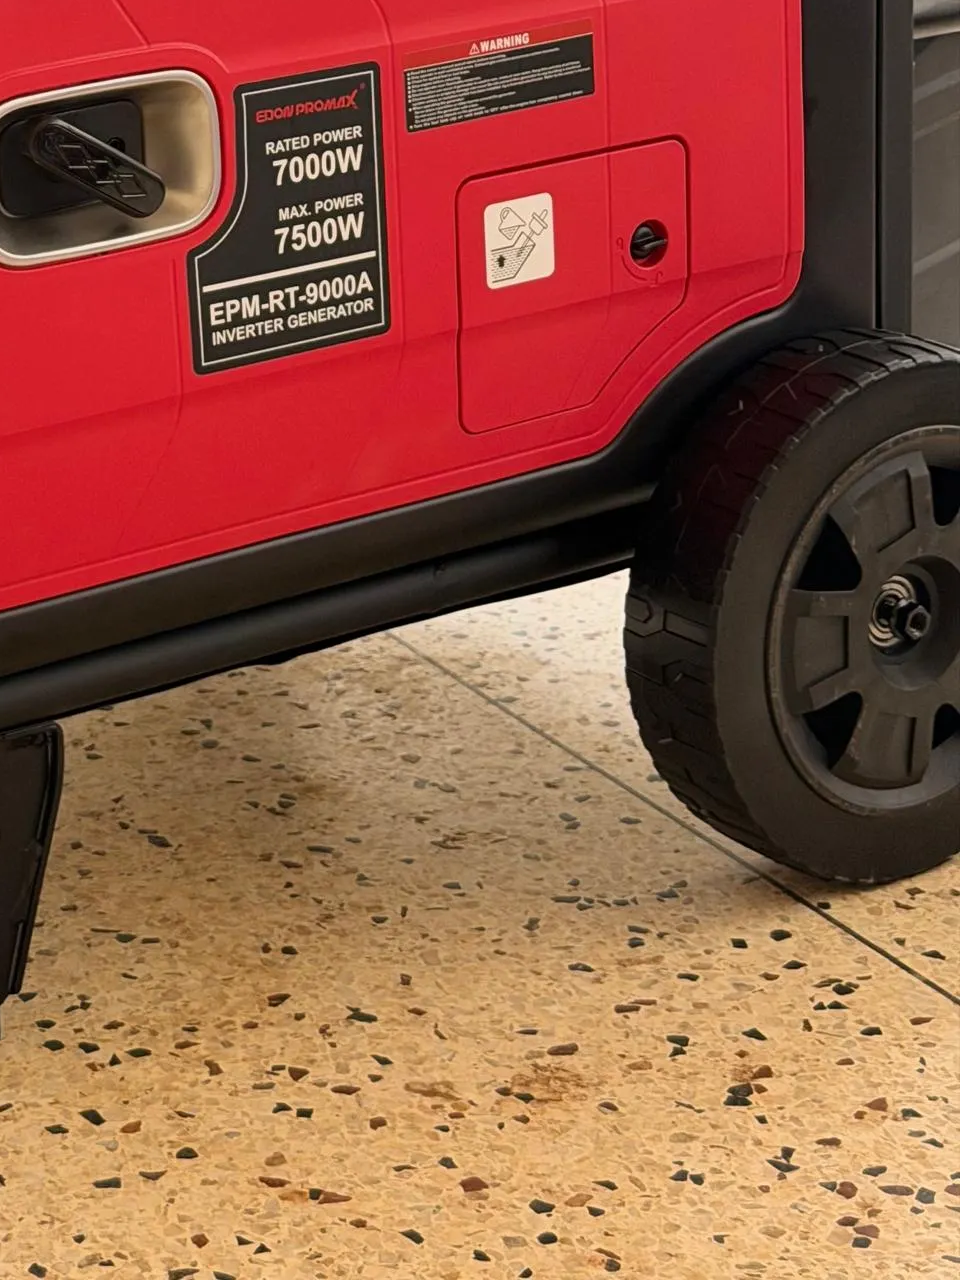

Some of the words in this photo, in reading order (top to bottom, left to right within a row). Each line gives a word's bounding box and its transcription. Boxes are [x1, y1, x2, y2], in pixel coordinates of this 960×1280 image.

[480, 33, 530, 53] WARNING
[255, 104, 295, 124] EDON
[295, 88, 359, 116] PROMAX
[265, 135, 310, 155] RATED
[313, 125, 363, 146] POWER
[272, 144, 363, 186] 7000W
[278, 204, 311, 221] MAX.
[315, 193, 364, 214] POWER
[274, 211, 365, 254] 7500W
[209, 271, 374, 326] EPM-RT-9000A
[212, 318, 284, 346] INVERTER
[287, 297, 374, 329] GENERATOR
